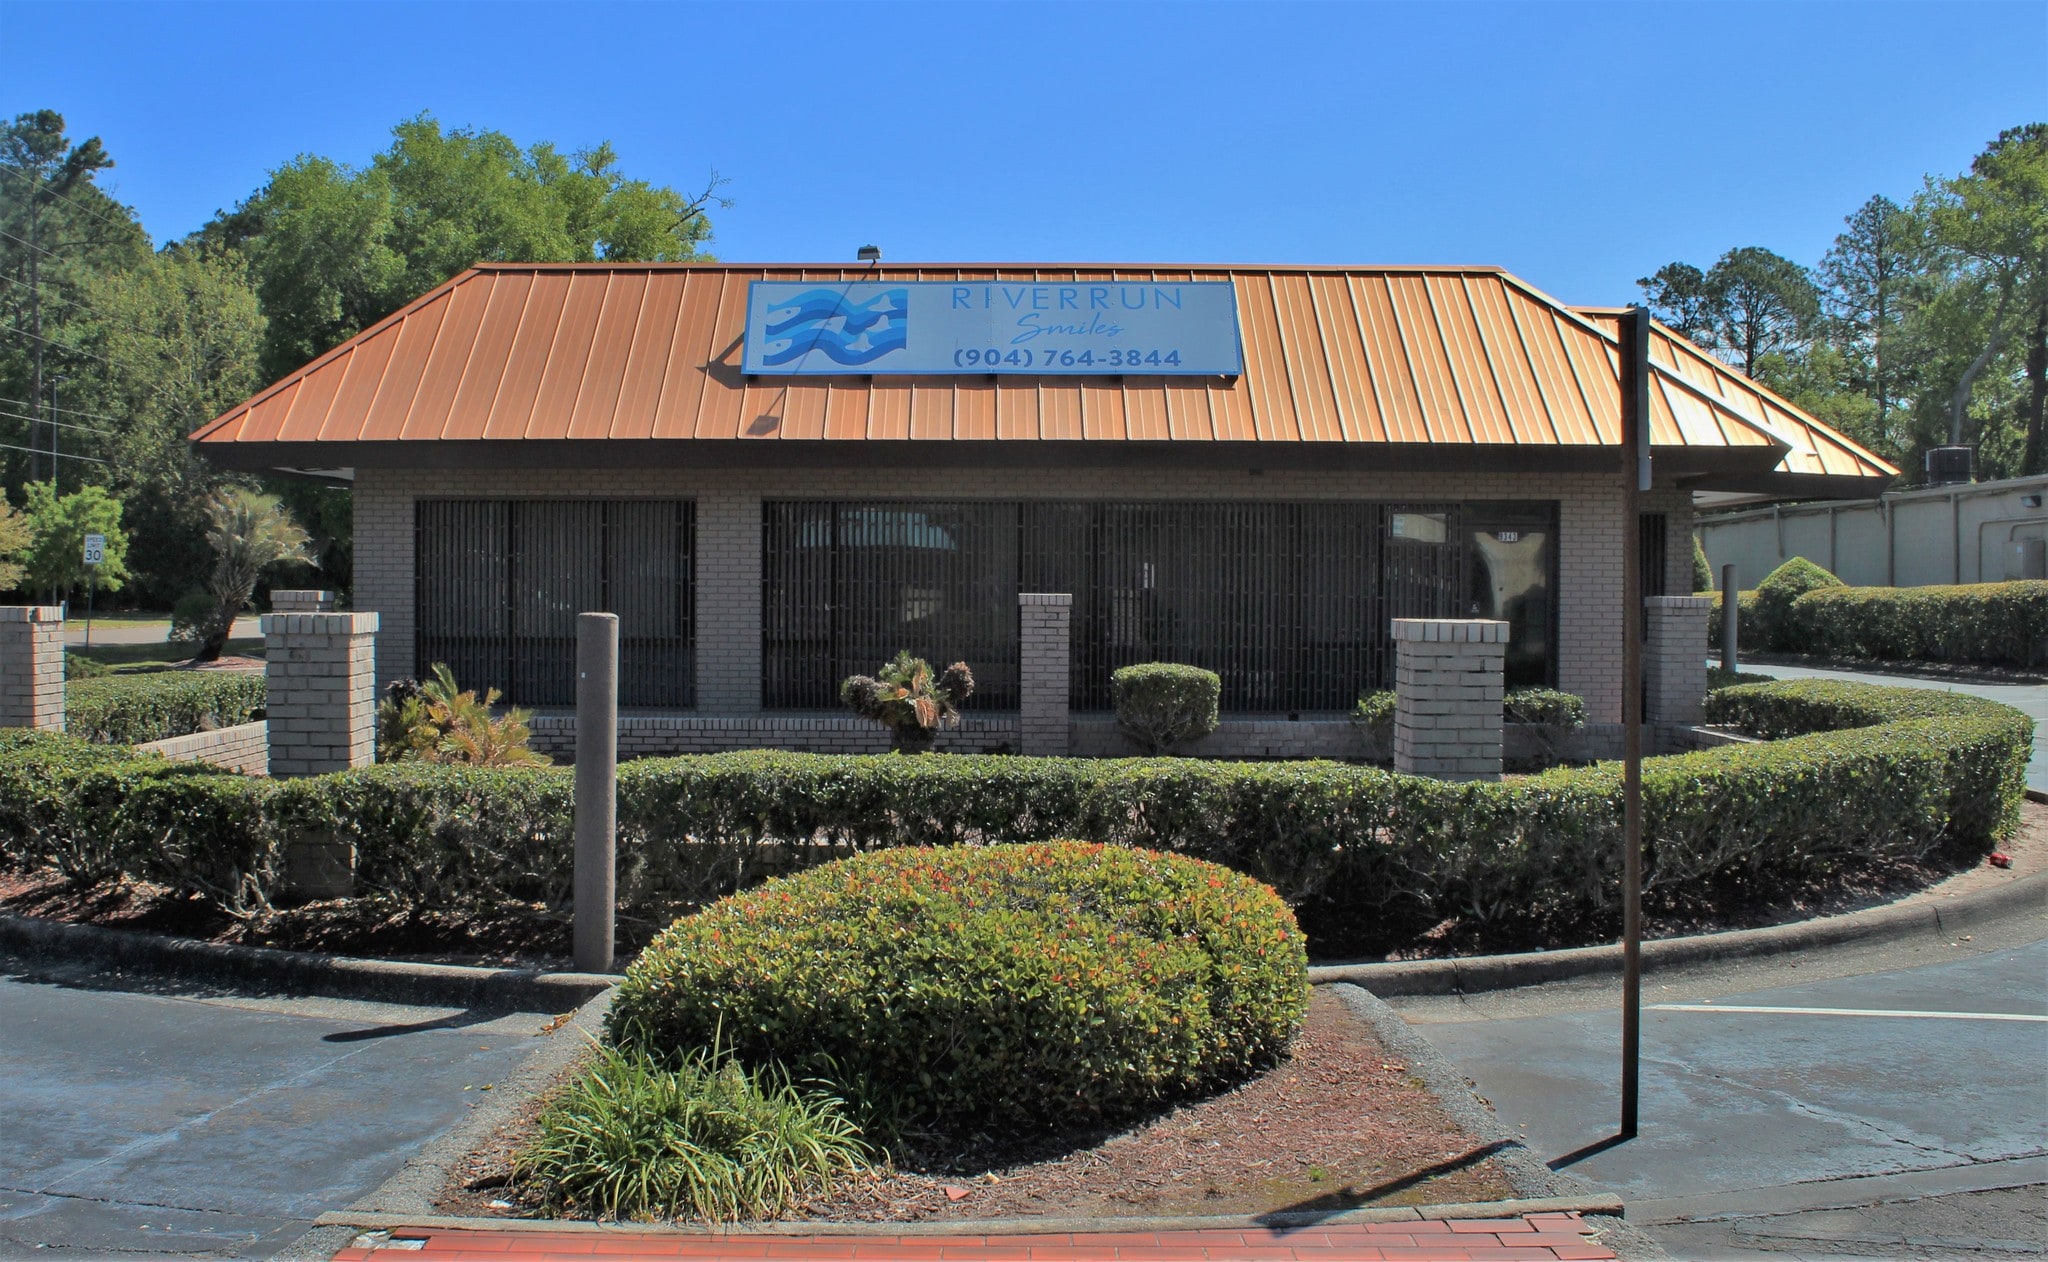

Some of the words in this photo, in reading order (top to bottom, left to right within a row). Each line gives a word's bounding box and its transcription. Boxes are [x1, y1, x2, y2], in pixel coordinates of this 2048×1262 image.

[952, 287, 1181, 309] RIVERRUN
[1011, 312, 1125, 344] Smiles
[954, 349, 1033, 367] (904)
[1044, 349, 1181, 367] 764-3844
[85, 550, 101, 560] 30
